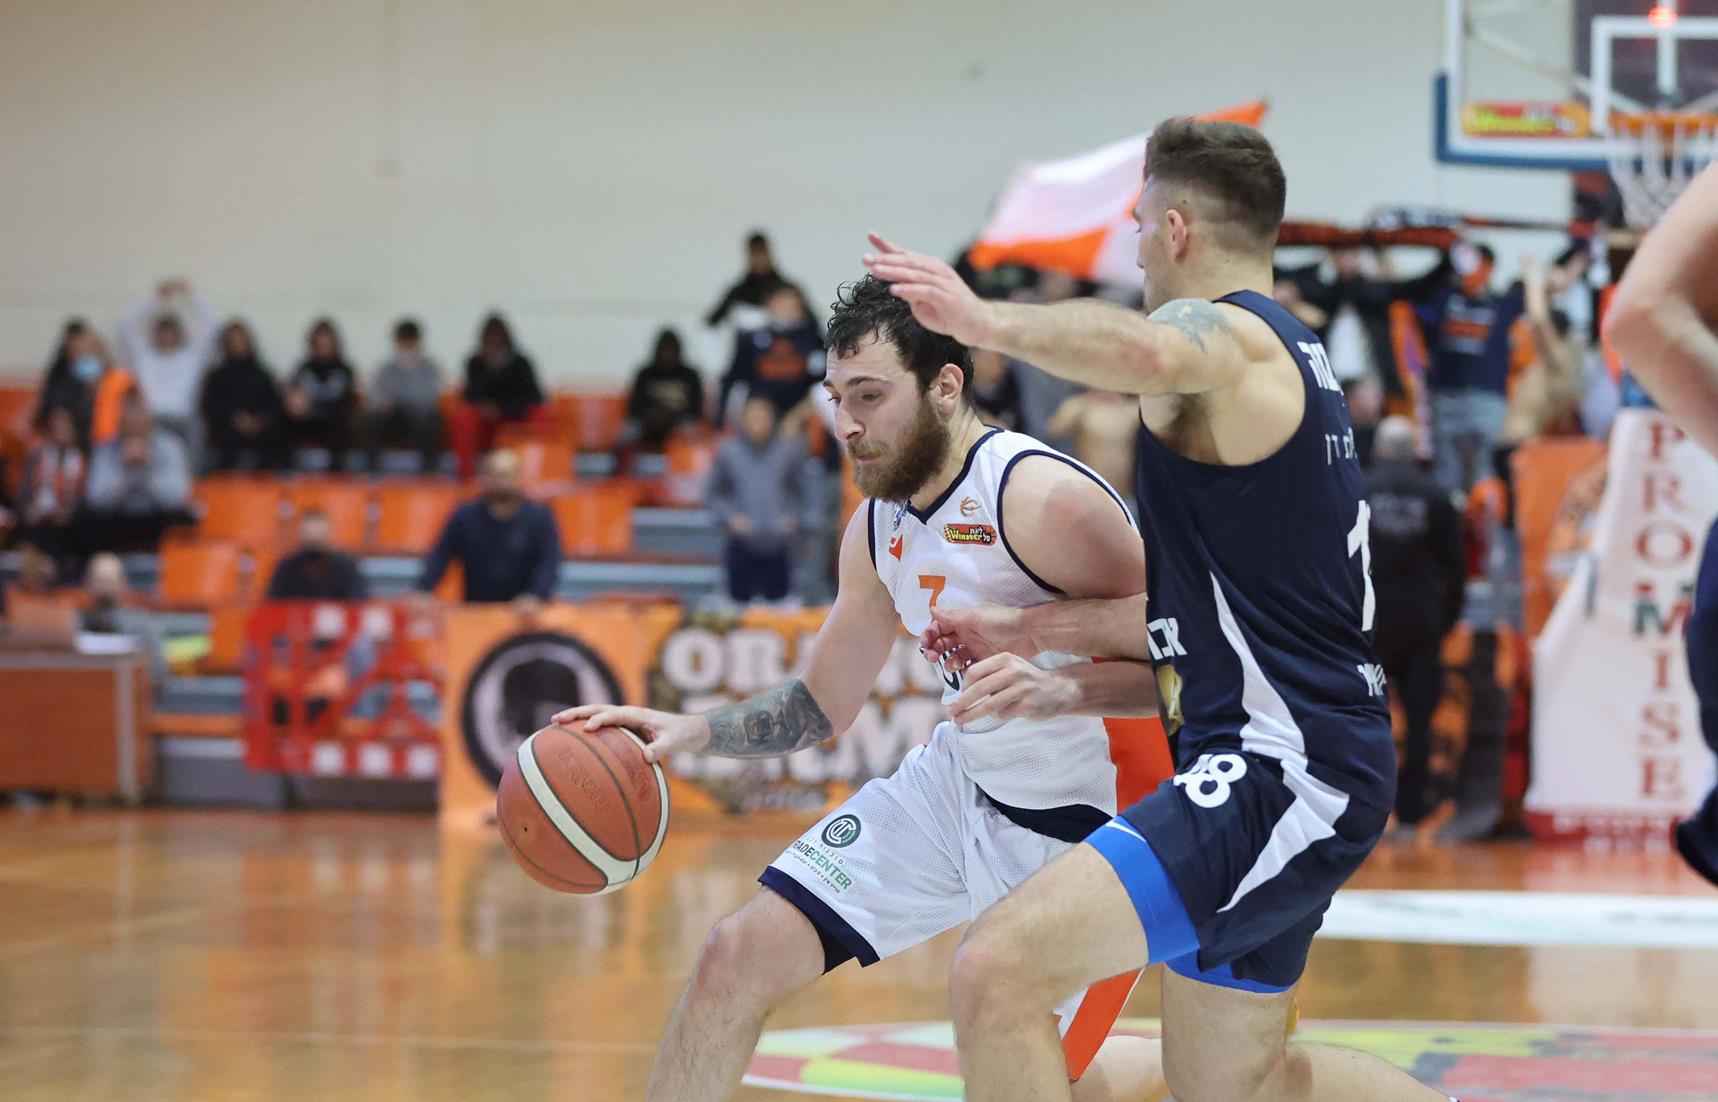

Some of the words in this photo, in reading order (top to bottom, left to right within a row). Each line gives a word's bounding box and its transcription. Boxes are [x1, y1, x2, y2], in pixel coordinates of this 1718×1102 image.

[949, 529, 982, 541] Winner
[918, 574, 946, 609] 7
[1634, 420, 1697, 803] PROMISE
[792, 840, 853, 889] RADECENTER
